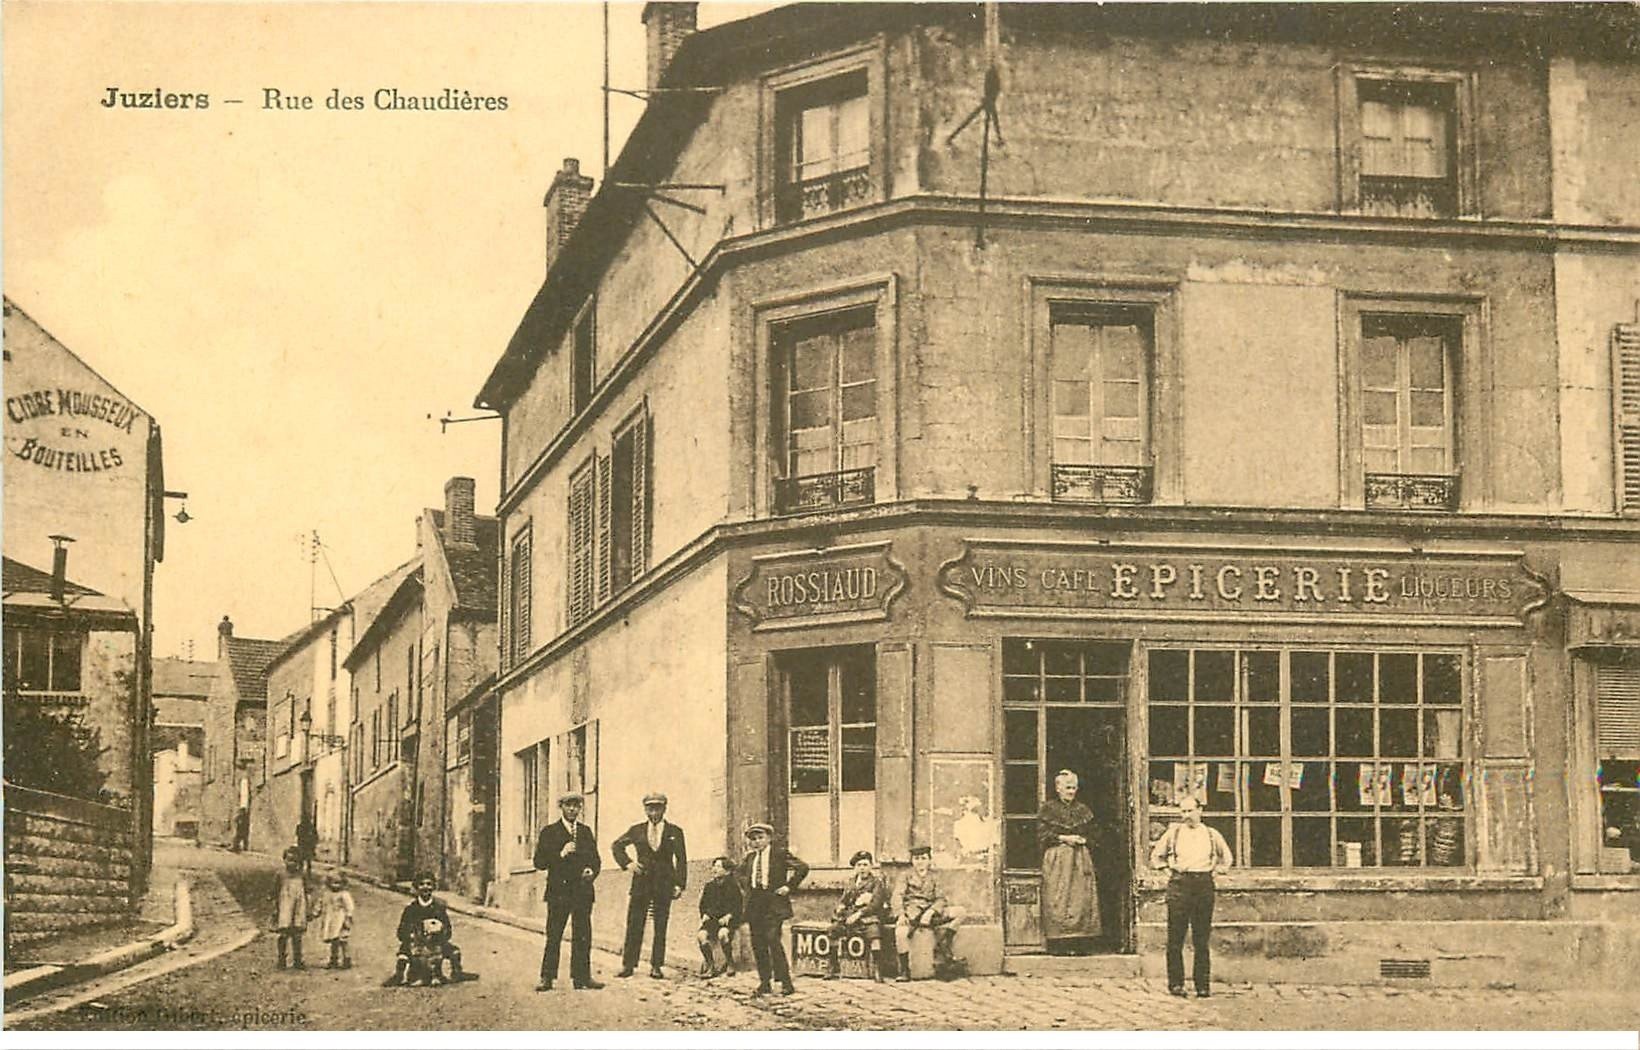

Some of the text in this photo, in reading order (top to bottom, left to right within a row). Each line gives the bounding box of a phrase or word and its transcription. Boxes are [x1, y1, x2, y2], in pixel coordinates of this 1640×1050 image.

[57, 388, 140, 435] MOUSSEUX
[61, 427, 89, 439] EN
[15, 437, 124, 473] BOUTEILLES
[767, 567, 878, 608] ROSSIAUD
[971, 566, 1028, 589] VINS
[1110, 563, 1391, 603] EPICERIE
[1400, 575, 1512, 600] LIQUEURS
